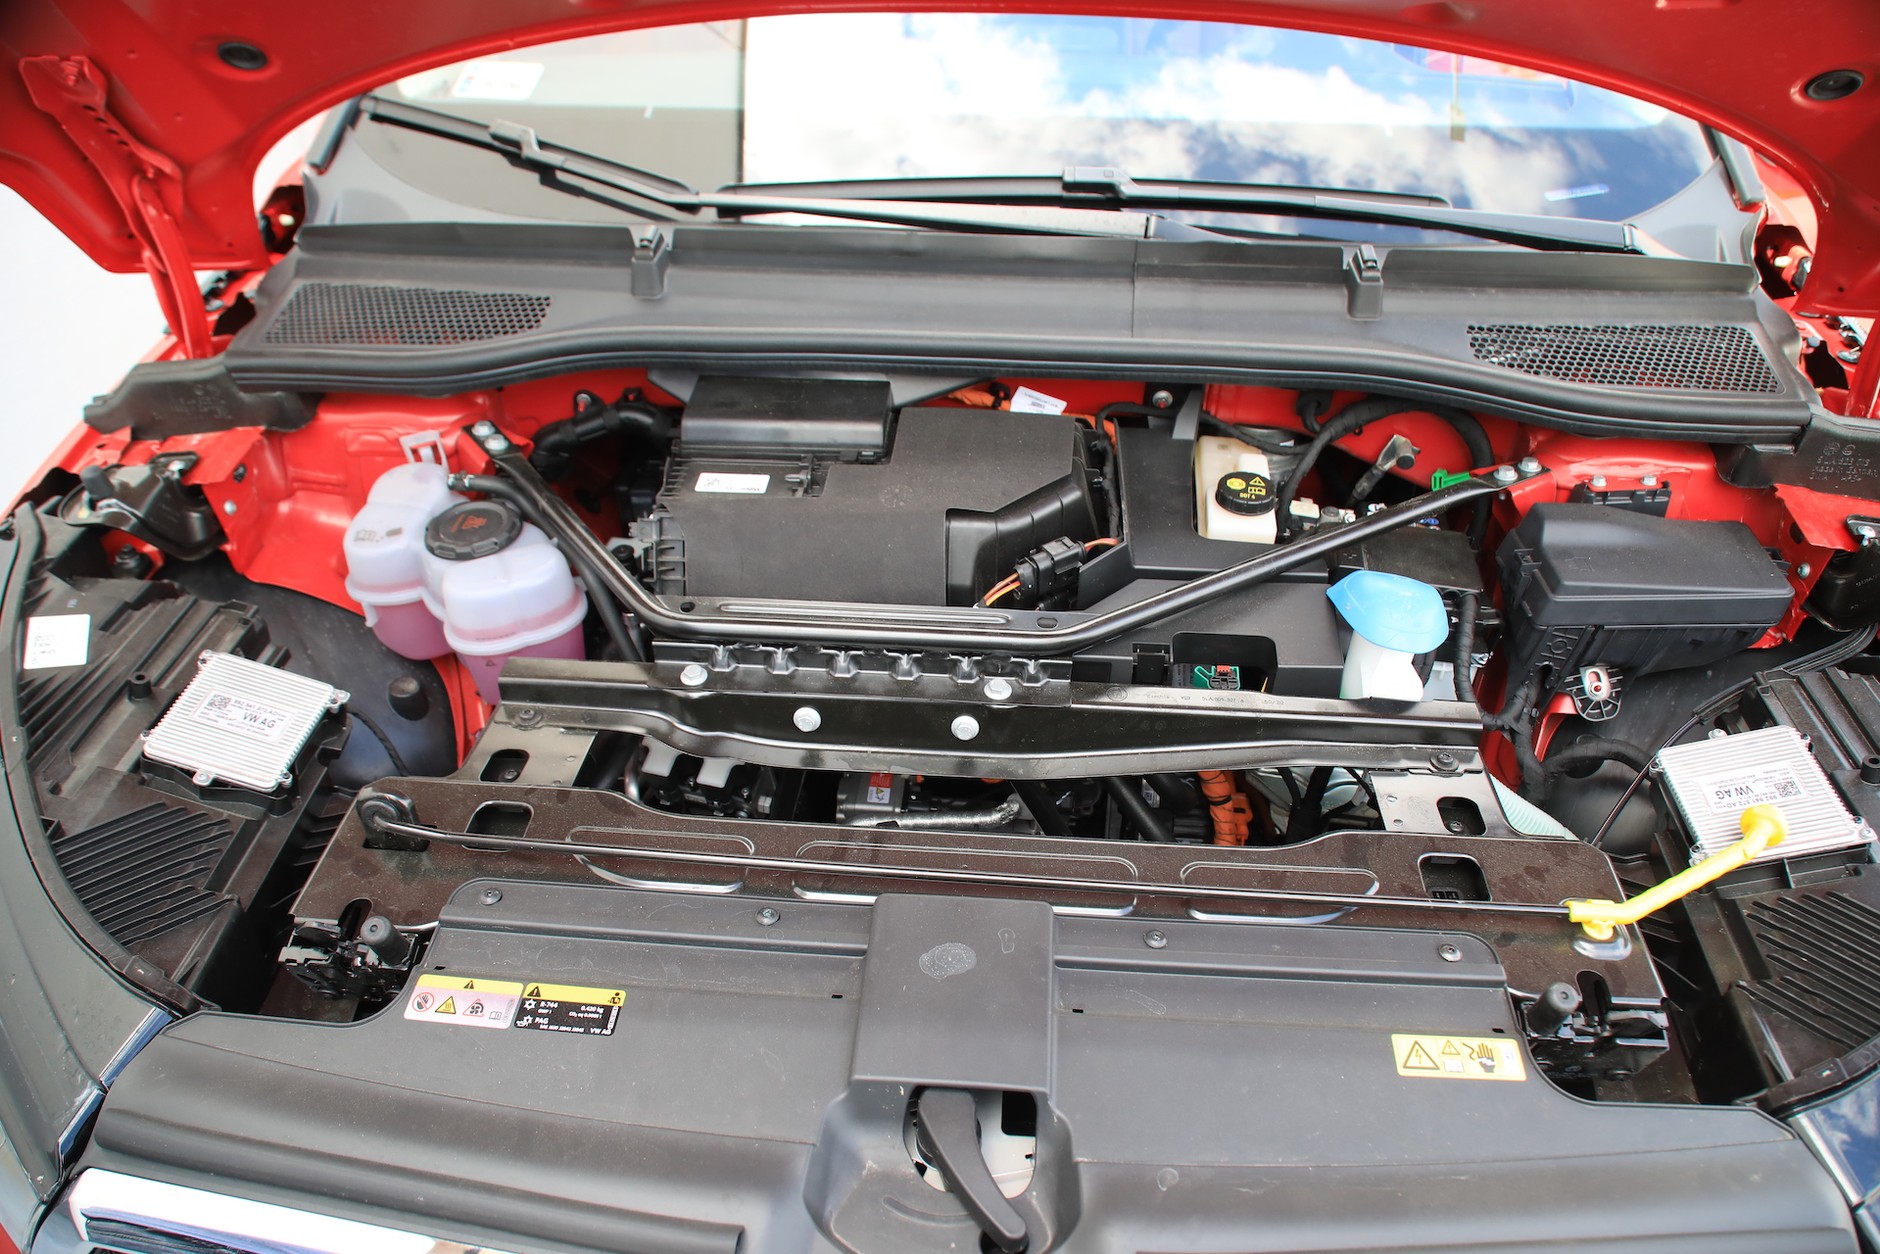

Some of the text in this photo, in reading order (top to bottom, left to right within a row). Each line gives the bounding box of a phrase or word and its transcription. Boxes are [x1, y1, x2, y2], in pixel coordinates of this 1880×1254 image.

[243, 712, 260, 723] VW
[259, 718, 276, 728] AG
[1714, 789, 1731, 800] AG
[1734, 785, 1754, 796] VW
